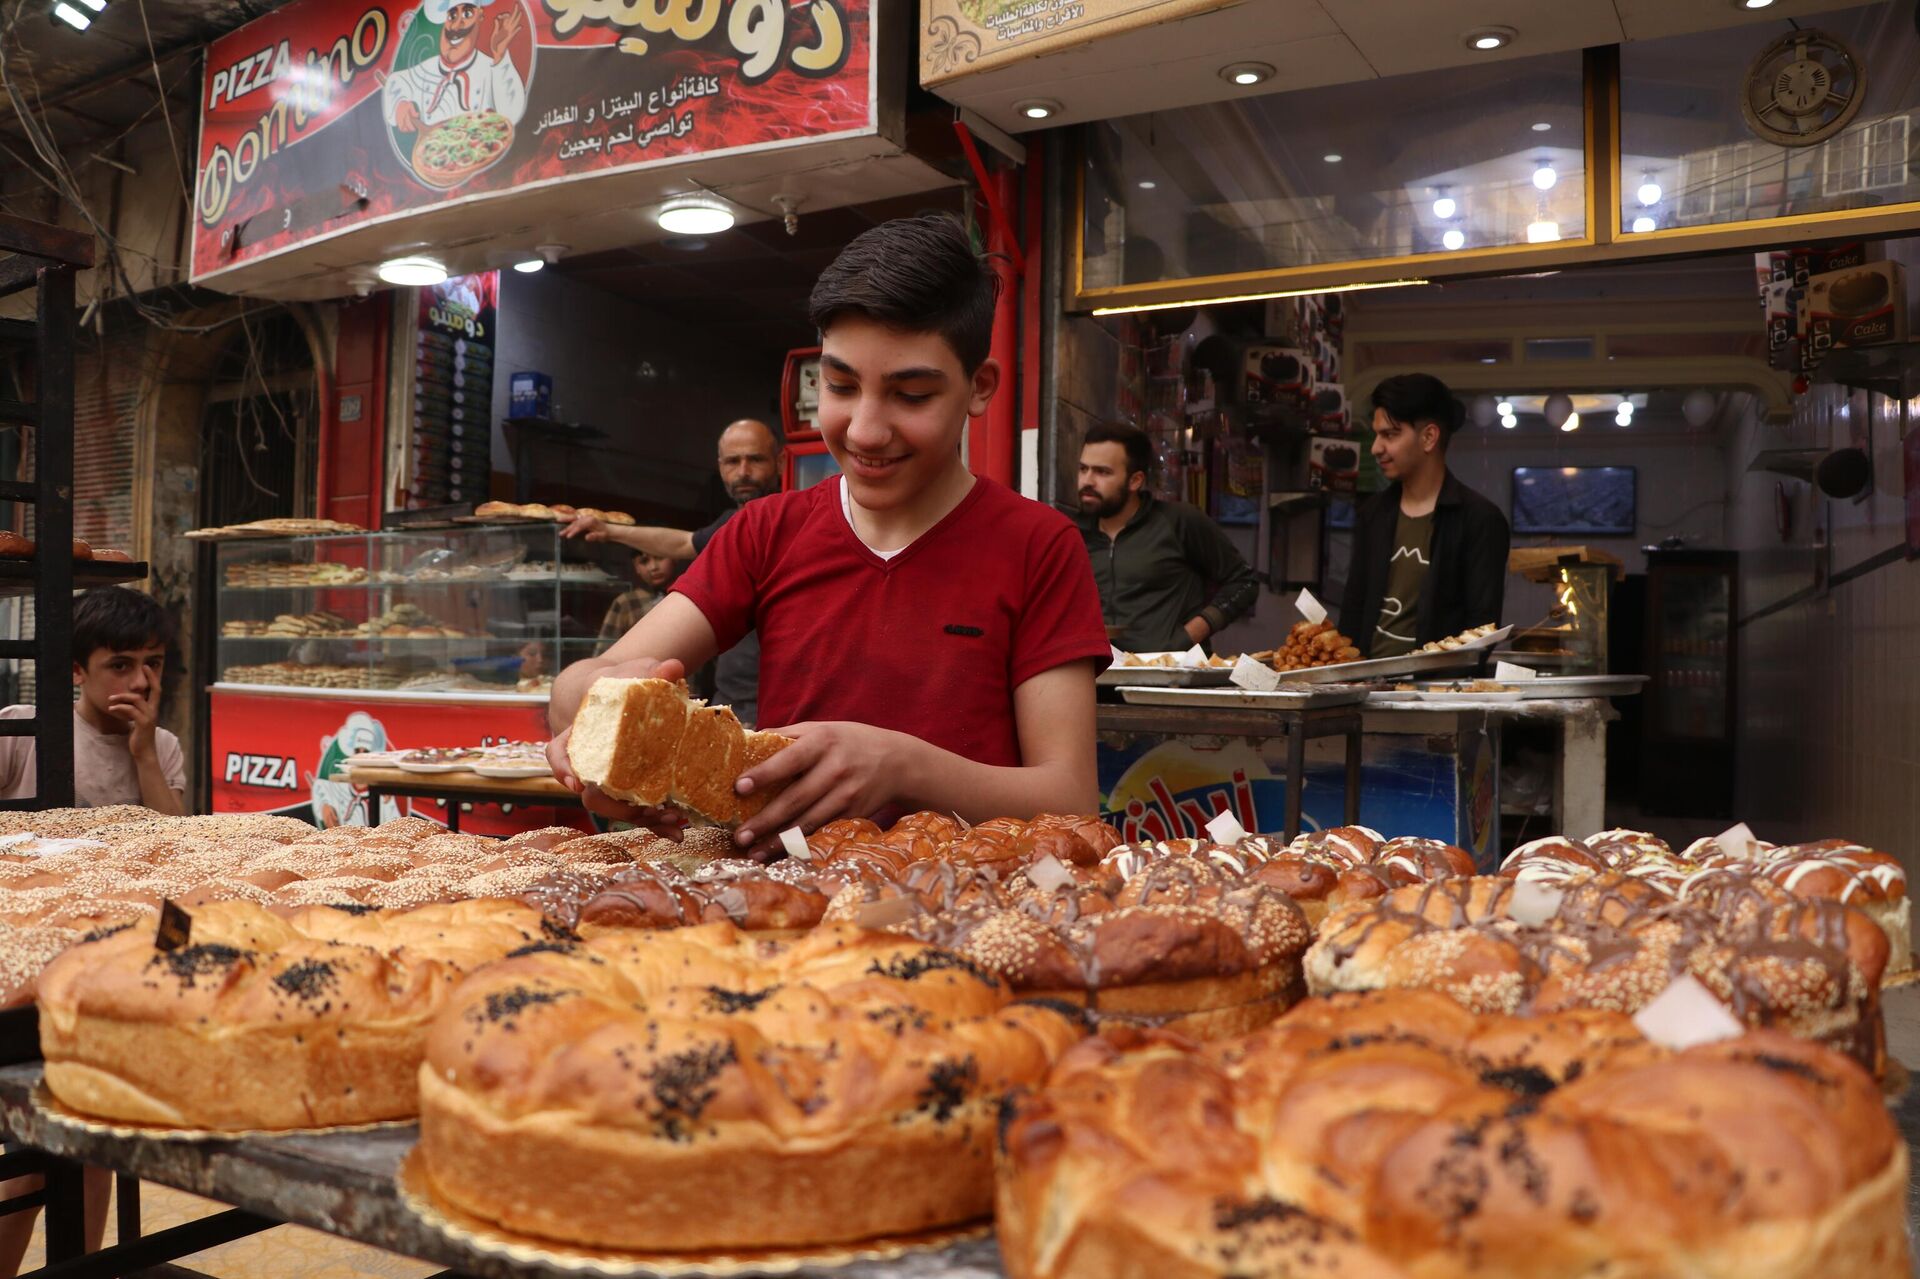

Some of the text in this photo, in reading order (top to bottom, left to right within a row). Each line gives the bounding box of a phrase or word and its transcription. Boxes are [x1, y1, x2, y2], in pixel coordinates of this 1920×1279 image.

[208, 40, 291, 110] PIZZA
[200, 9, 387, 225] Domino
[606, 123, 634, 151] لحم
[1853, 320, 1888, 337] Cake
[224, 752, 299, 790] PIZZA
